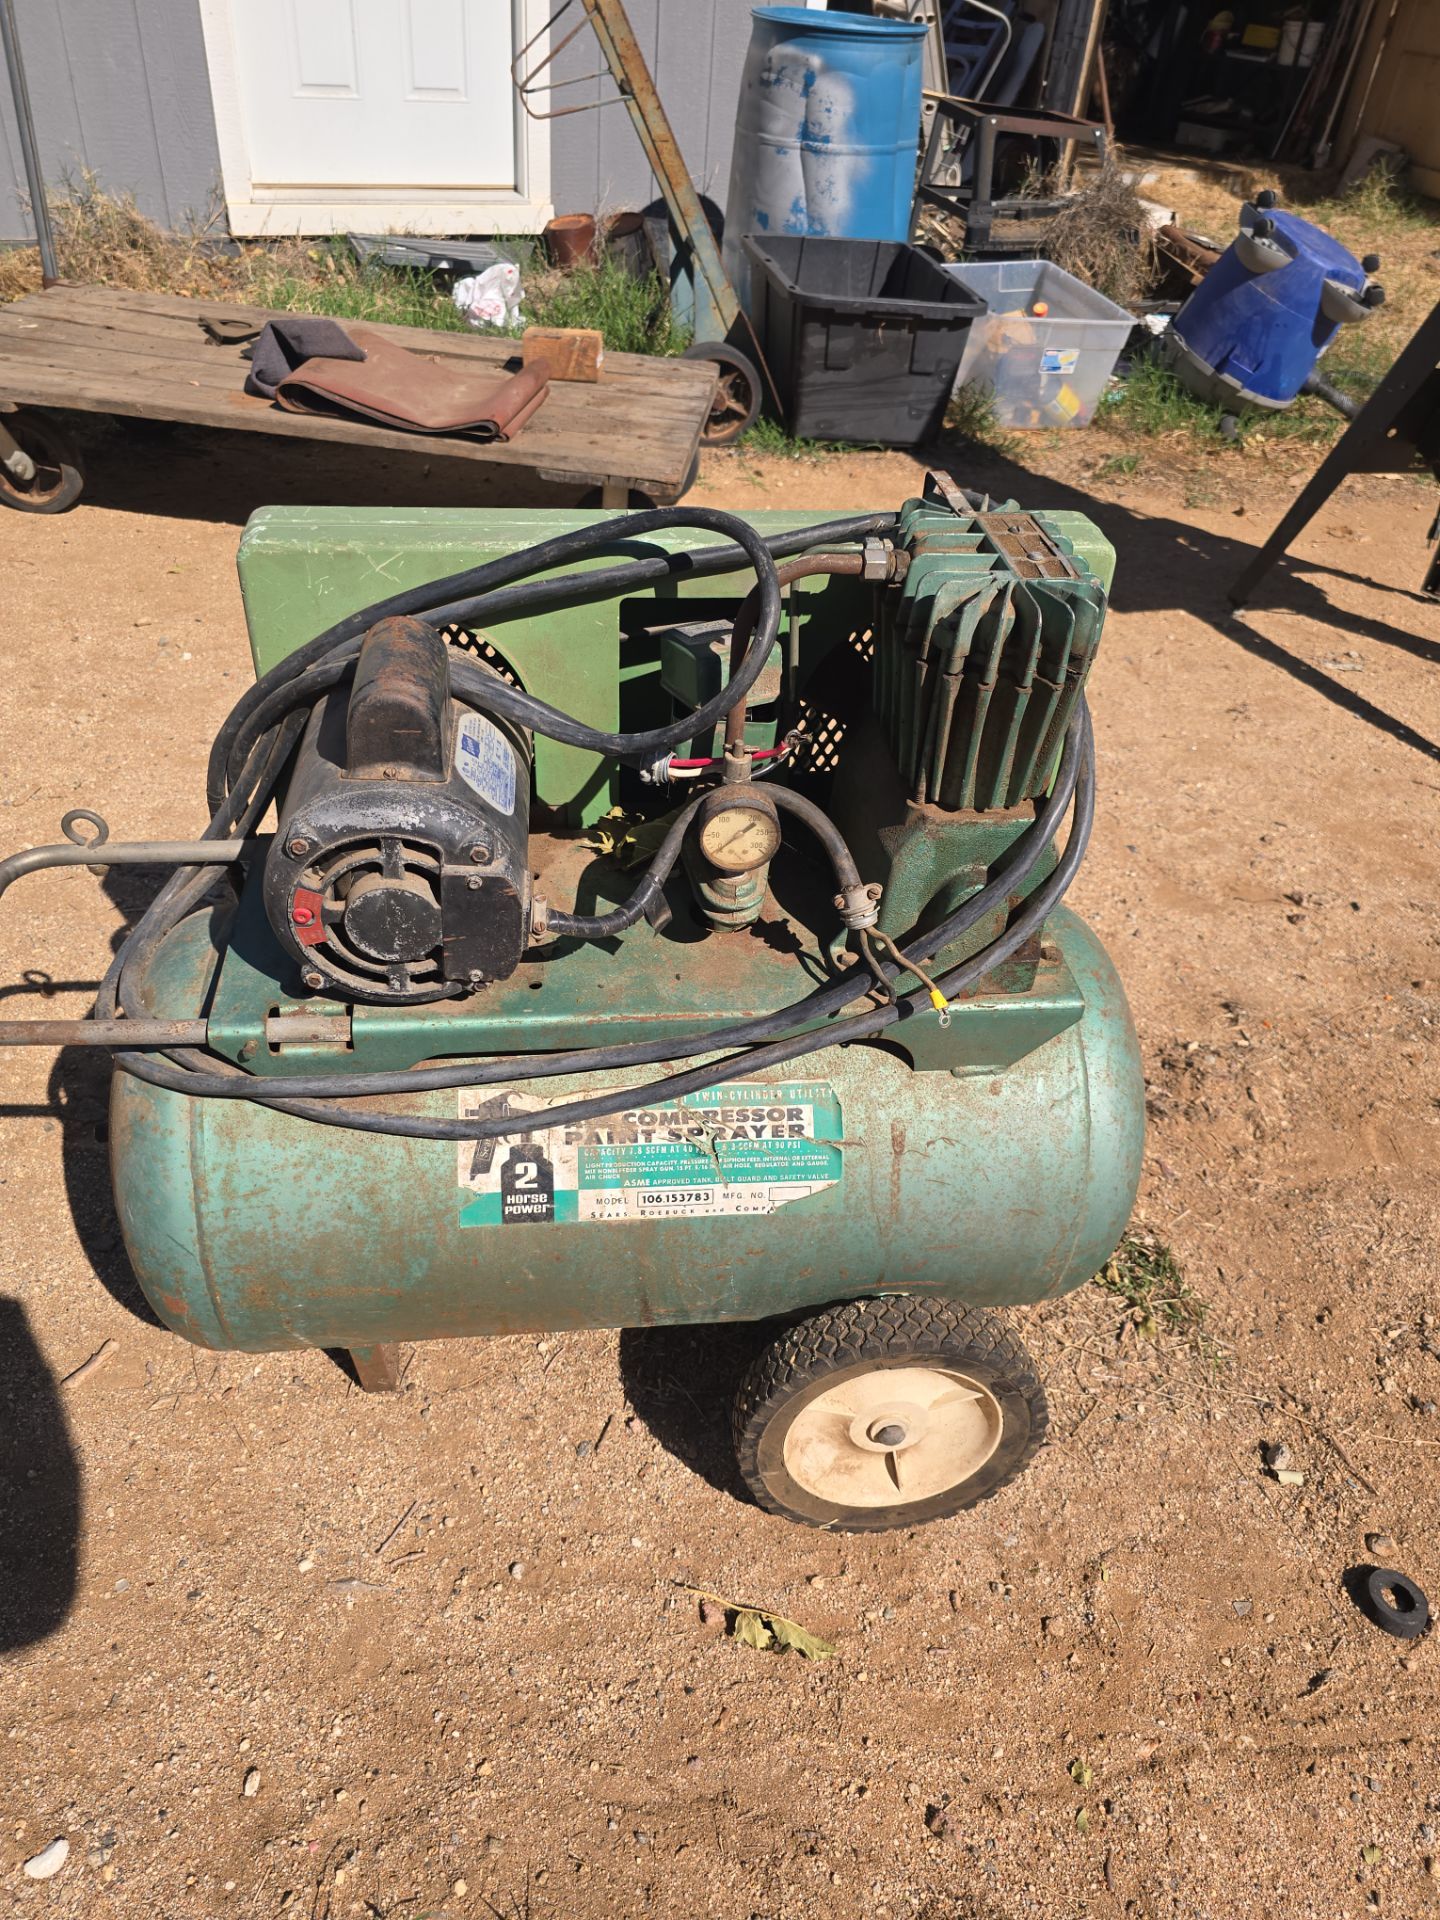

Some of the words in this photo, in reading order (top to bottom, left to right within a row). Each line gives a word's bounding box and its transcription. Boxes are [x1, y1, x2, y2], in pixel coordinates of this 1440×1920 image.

[711, 831, 721, 839] 50
[695, 1089, 783, 1102] TWIN-CYLINDER
[789, 1087, 834, 1099] UTILITY
[622, 1107, 804, 1127] COMPRESSOR
[667, 1124, 806, 1143] SPRAYER
[584, 1147, 626, 1157] CAACITY
[645, 1145, 667, 1155] SCFM
[670, 1144, 680, 1153] AT
[683, 1143, 693, 1153] 40
[762, 1141, 772, 1150] AT
[775, 1140, 785, 1149] 90
[787, 1140, 801, 1149] PSI
[515, 1162, 539, 1189] 2
[623, 1178, 651, 1187] ASME
[652, 1178, 691, 1186] APPROVED
[595, 1197, 629, 1205] MODEL
[641, 1192, 710, 1204] 106.153783
